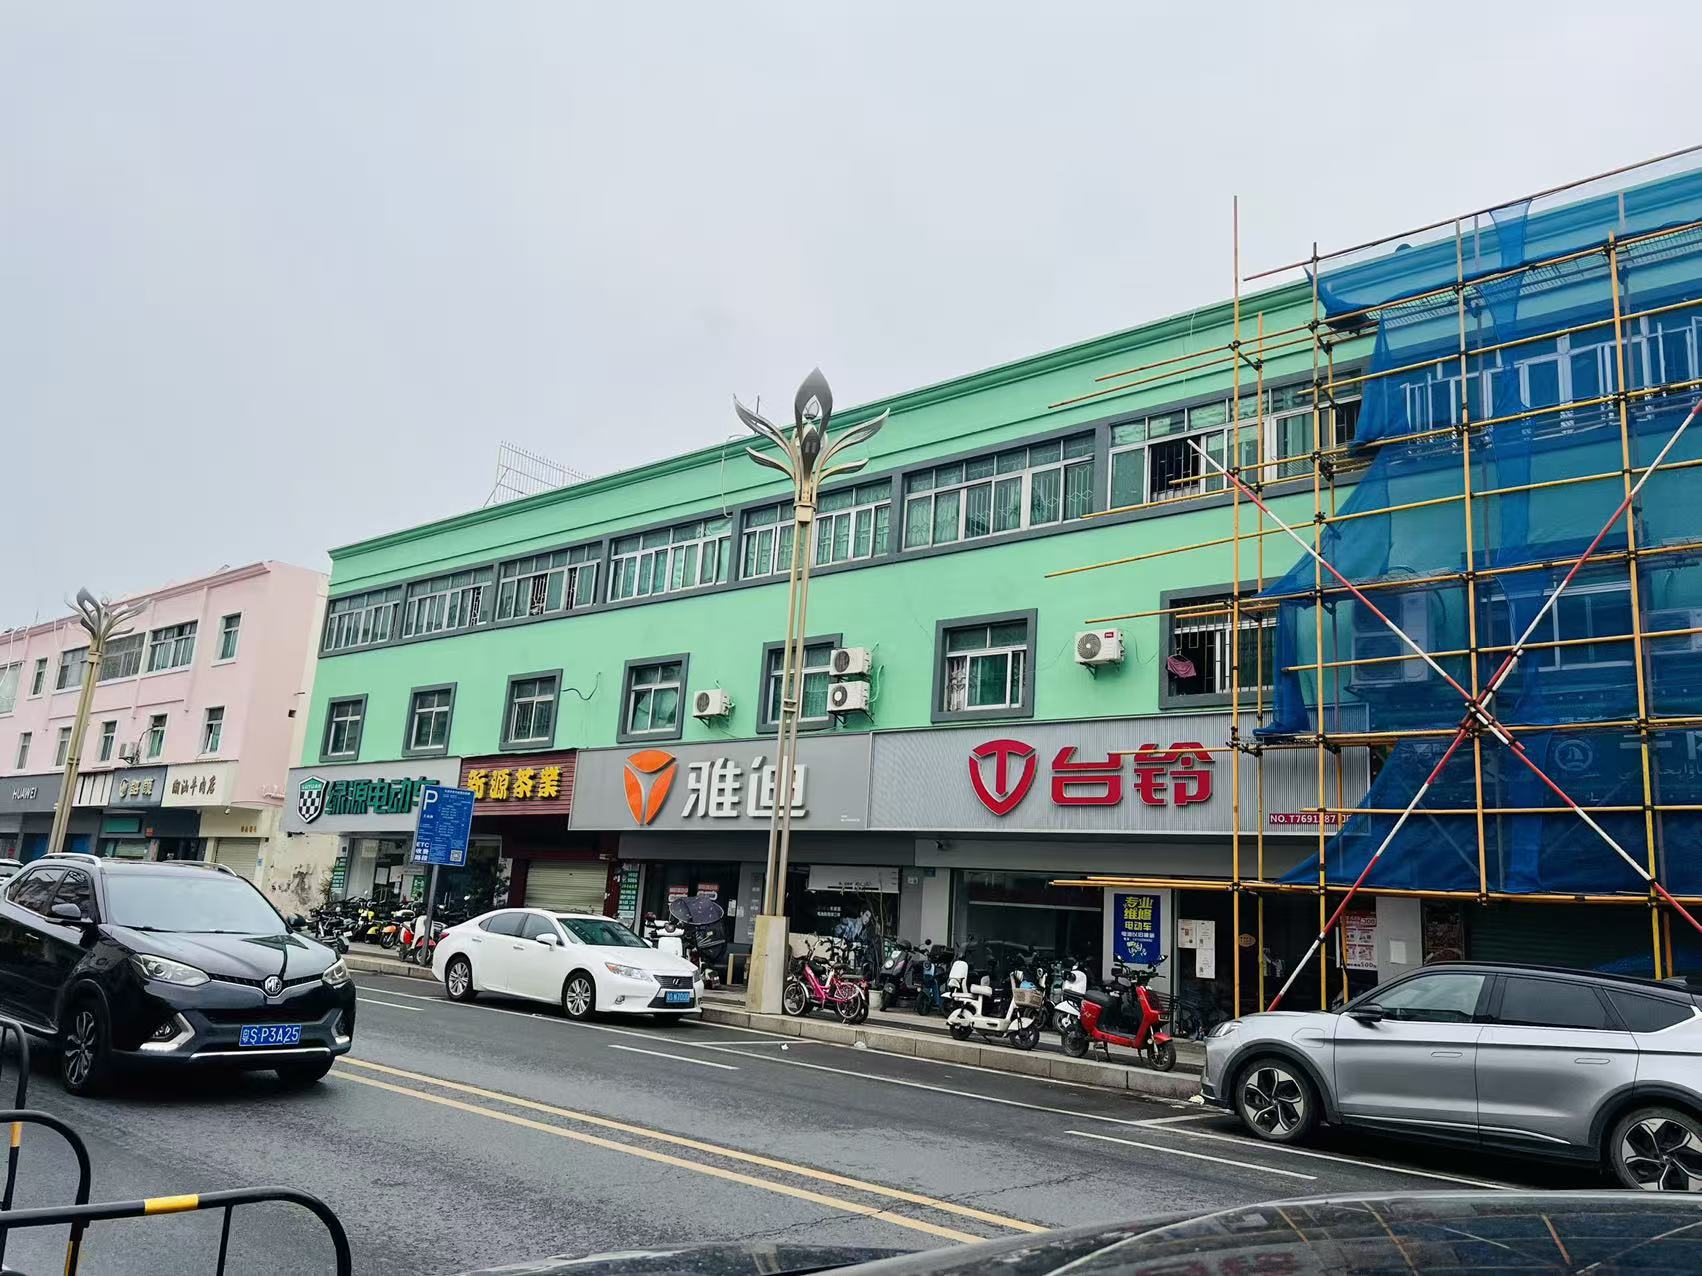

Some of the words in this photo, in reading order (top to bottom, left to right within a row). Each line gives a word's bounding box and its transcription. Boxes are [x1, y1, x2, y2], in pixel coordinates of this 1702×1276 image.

[1051, 742, 1215, 807] 台铃
[681, 756, 809, 818] 雅迪
[423, 789, 439, 811] P
[1289, 814, 1336, 824] T769187
[1125, 896, 1153, 908] 专业
[1123, 908, 1152, 920] 维修
[1124, 921, 1152, 931] 电动车
